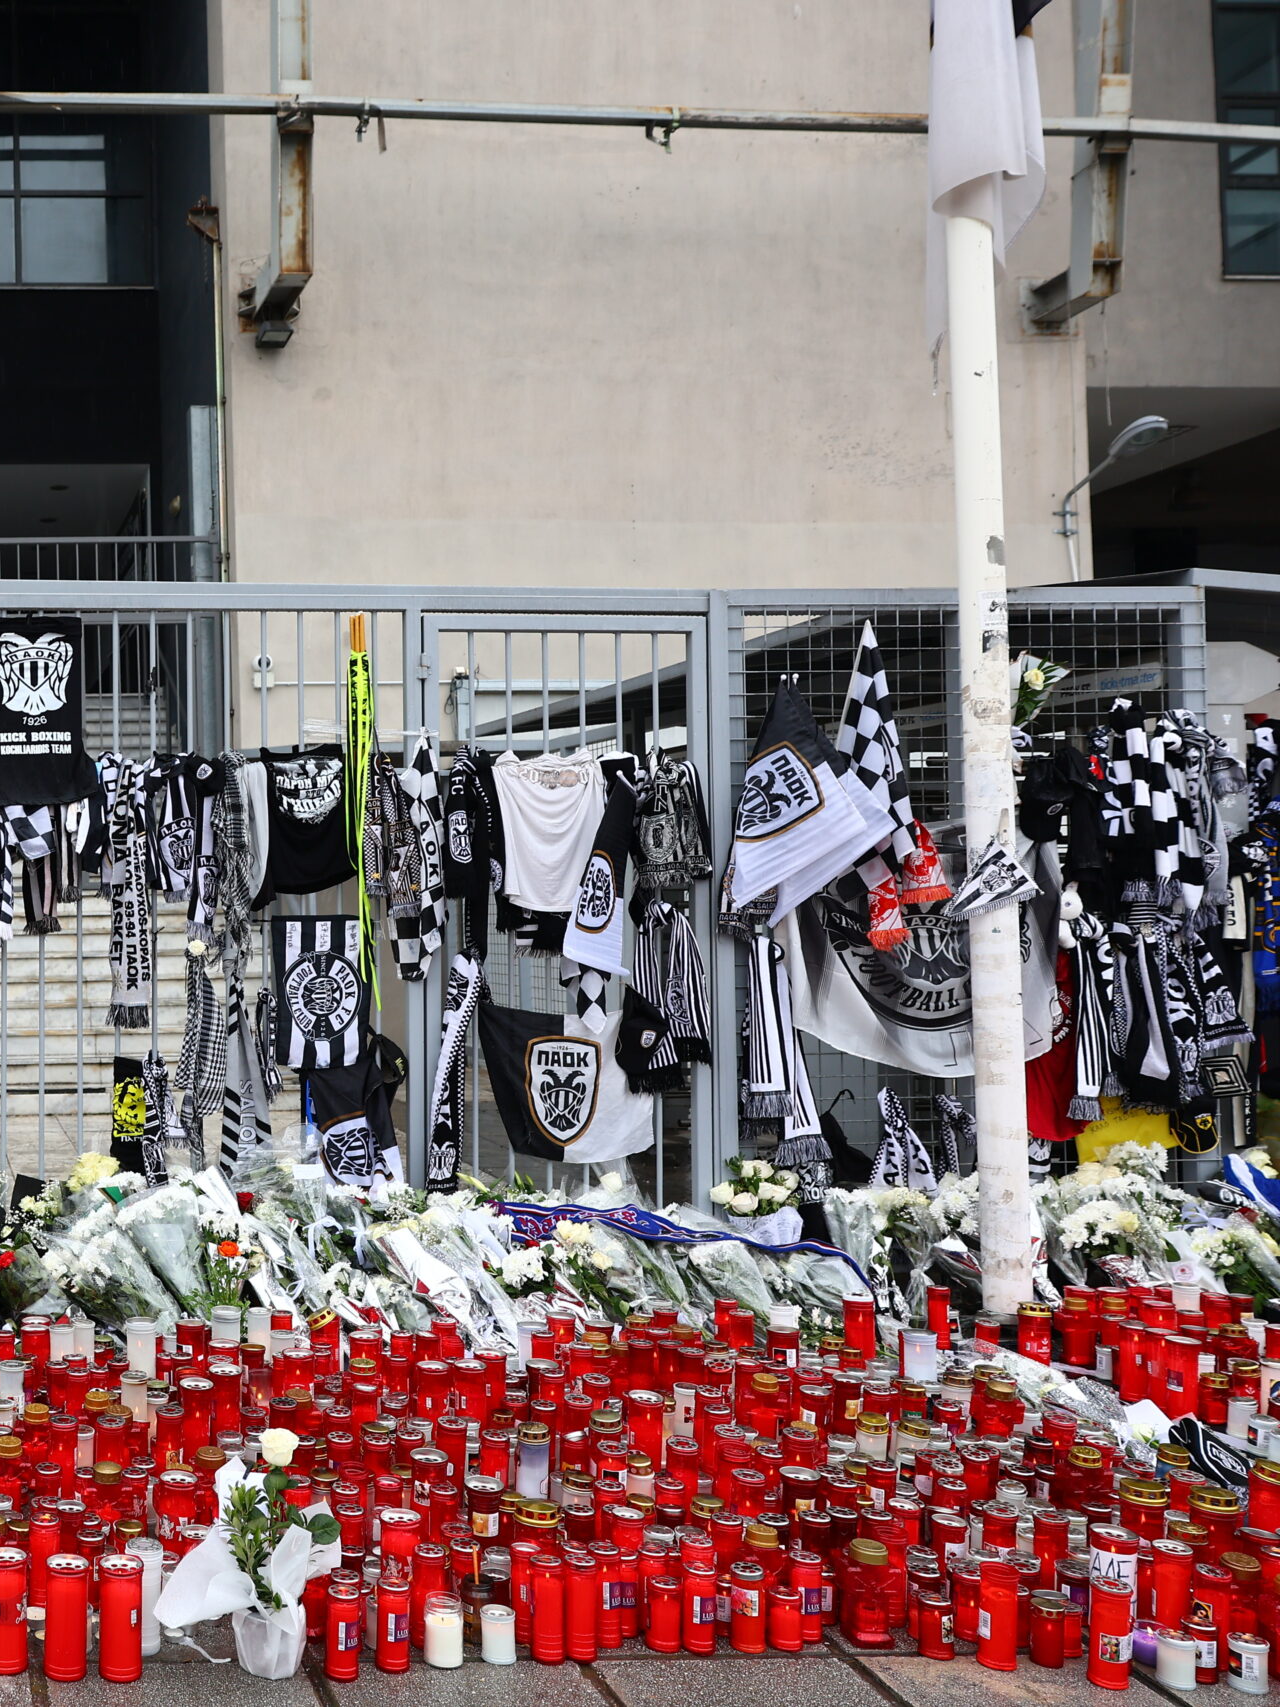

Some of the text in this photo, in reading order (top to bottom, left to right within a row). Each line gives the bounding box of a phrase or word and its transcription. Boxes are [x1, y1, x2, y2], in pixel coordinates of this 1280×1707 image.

[22, 715, 48, 727] 1926
[0, 731, 72, 743] KICK BOXING
[0, 743, 72, 756] KOCHLIARIDIS TEAM
[770, 754, 813, 808] ΠΑΟΚ
[110, 883, 124, 966] BASKET
[126, 944, 138, 991] ΠΑΟΚ
[850, 948, 960, 1012] FOOTBALL
[334, 964, 356, 1027] PAOK FC
[293, 1006, 313, 1031] CLUB
[536, 1049, 590, 1069] ΠΑΟΚ
[622, 1596, 636, 1606] LUX
[806, 1604, 821, 1613] LUX
[702, 1612, 715, 1621] LUX
[396, 1629, 410, 1639] LUX
[347, 1636, 359, 1647] LUX
